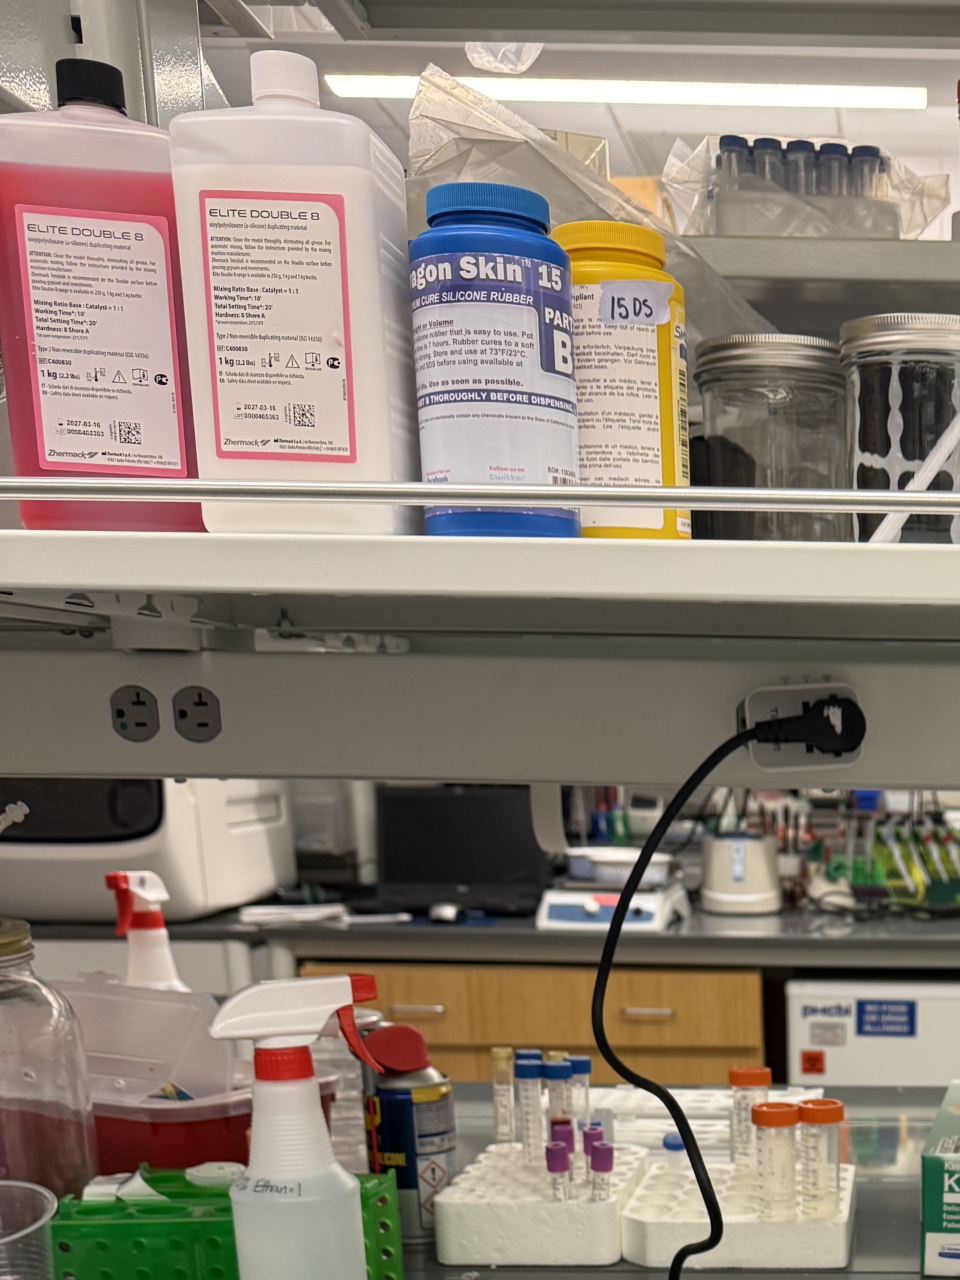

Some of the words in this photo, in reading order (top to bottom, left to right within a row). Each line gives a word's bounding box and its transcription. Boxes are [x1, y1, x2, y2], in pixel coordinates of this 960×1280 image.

[209, 208, 247, 218] ELITE
[250, 210, 308, 220] DOUBLE
[310, 212, 320, 220] 8
[27, 223, 68, 235] ELITE
[72, 227, 131, 240] DOUBLE
[134, 232, 144, 241] 8
[538, 264, 562, 292] 15
[421, 292, 440, 305] CURE
[441, 291, 488, 302] SILICONE
[490, 291, 534, 306] RUBBER
[50, 317, 70, 325] Setting
[428, 318, 454, 328] Volume
[544, 306, 573, 332] PART
[430, 329, 448, 338] rubber
[450, 328, 463, 336] that
[522, 331, 534, 339] Pot
[452, 338, 478, 346] Rubber
[504, 339, 512, 347] to
[450, 348, 462, 356] and
[554, 328, 573, 375] B
[224, 357, 234, 367] kg
[437, 358, 456, 367] before
[458, 358, 478, 366] using
[480, 358, 513, 366] available
[47, 370, 58, 380] kg
[429, 380, 439, 388] Use
[484, 378, 523, 387] possible.
[430, 392, 487, 404] THOROUGHLY
[490, 392, 529, 403] BEFORE
[224, 438, 260, 447] Zhermack
[48, 449, 87, 459] Zhermack
[254, 1178, 301, 1197] Ethanol
